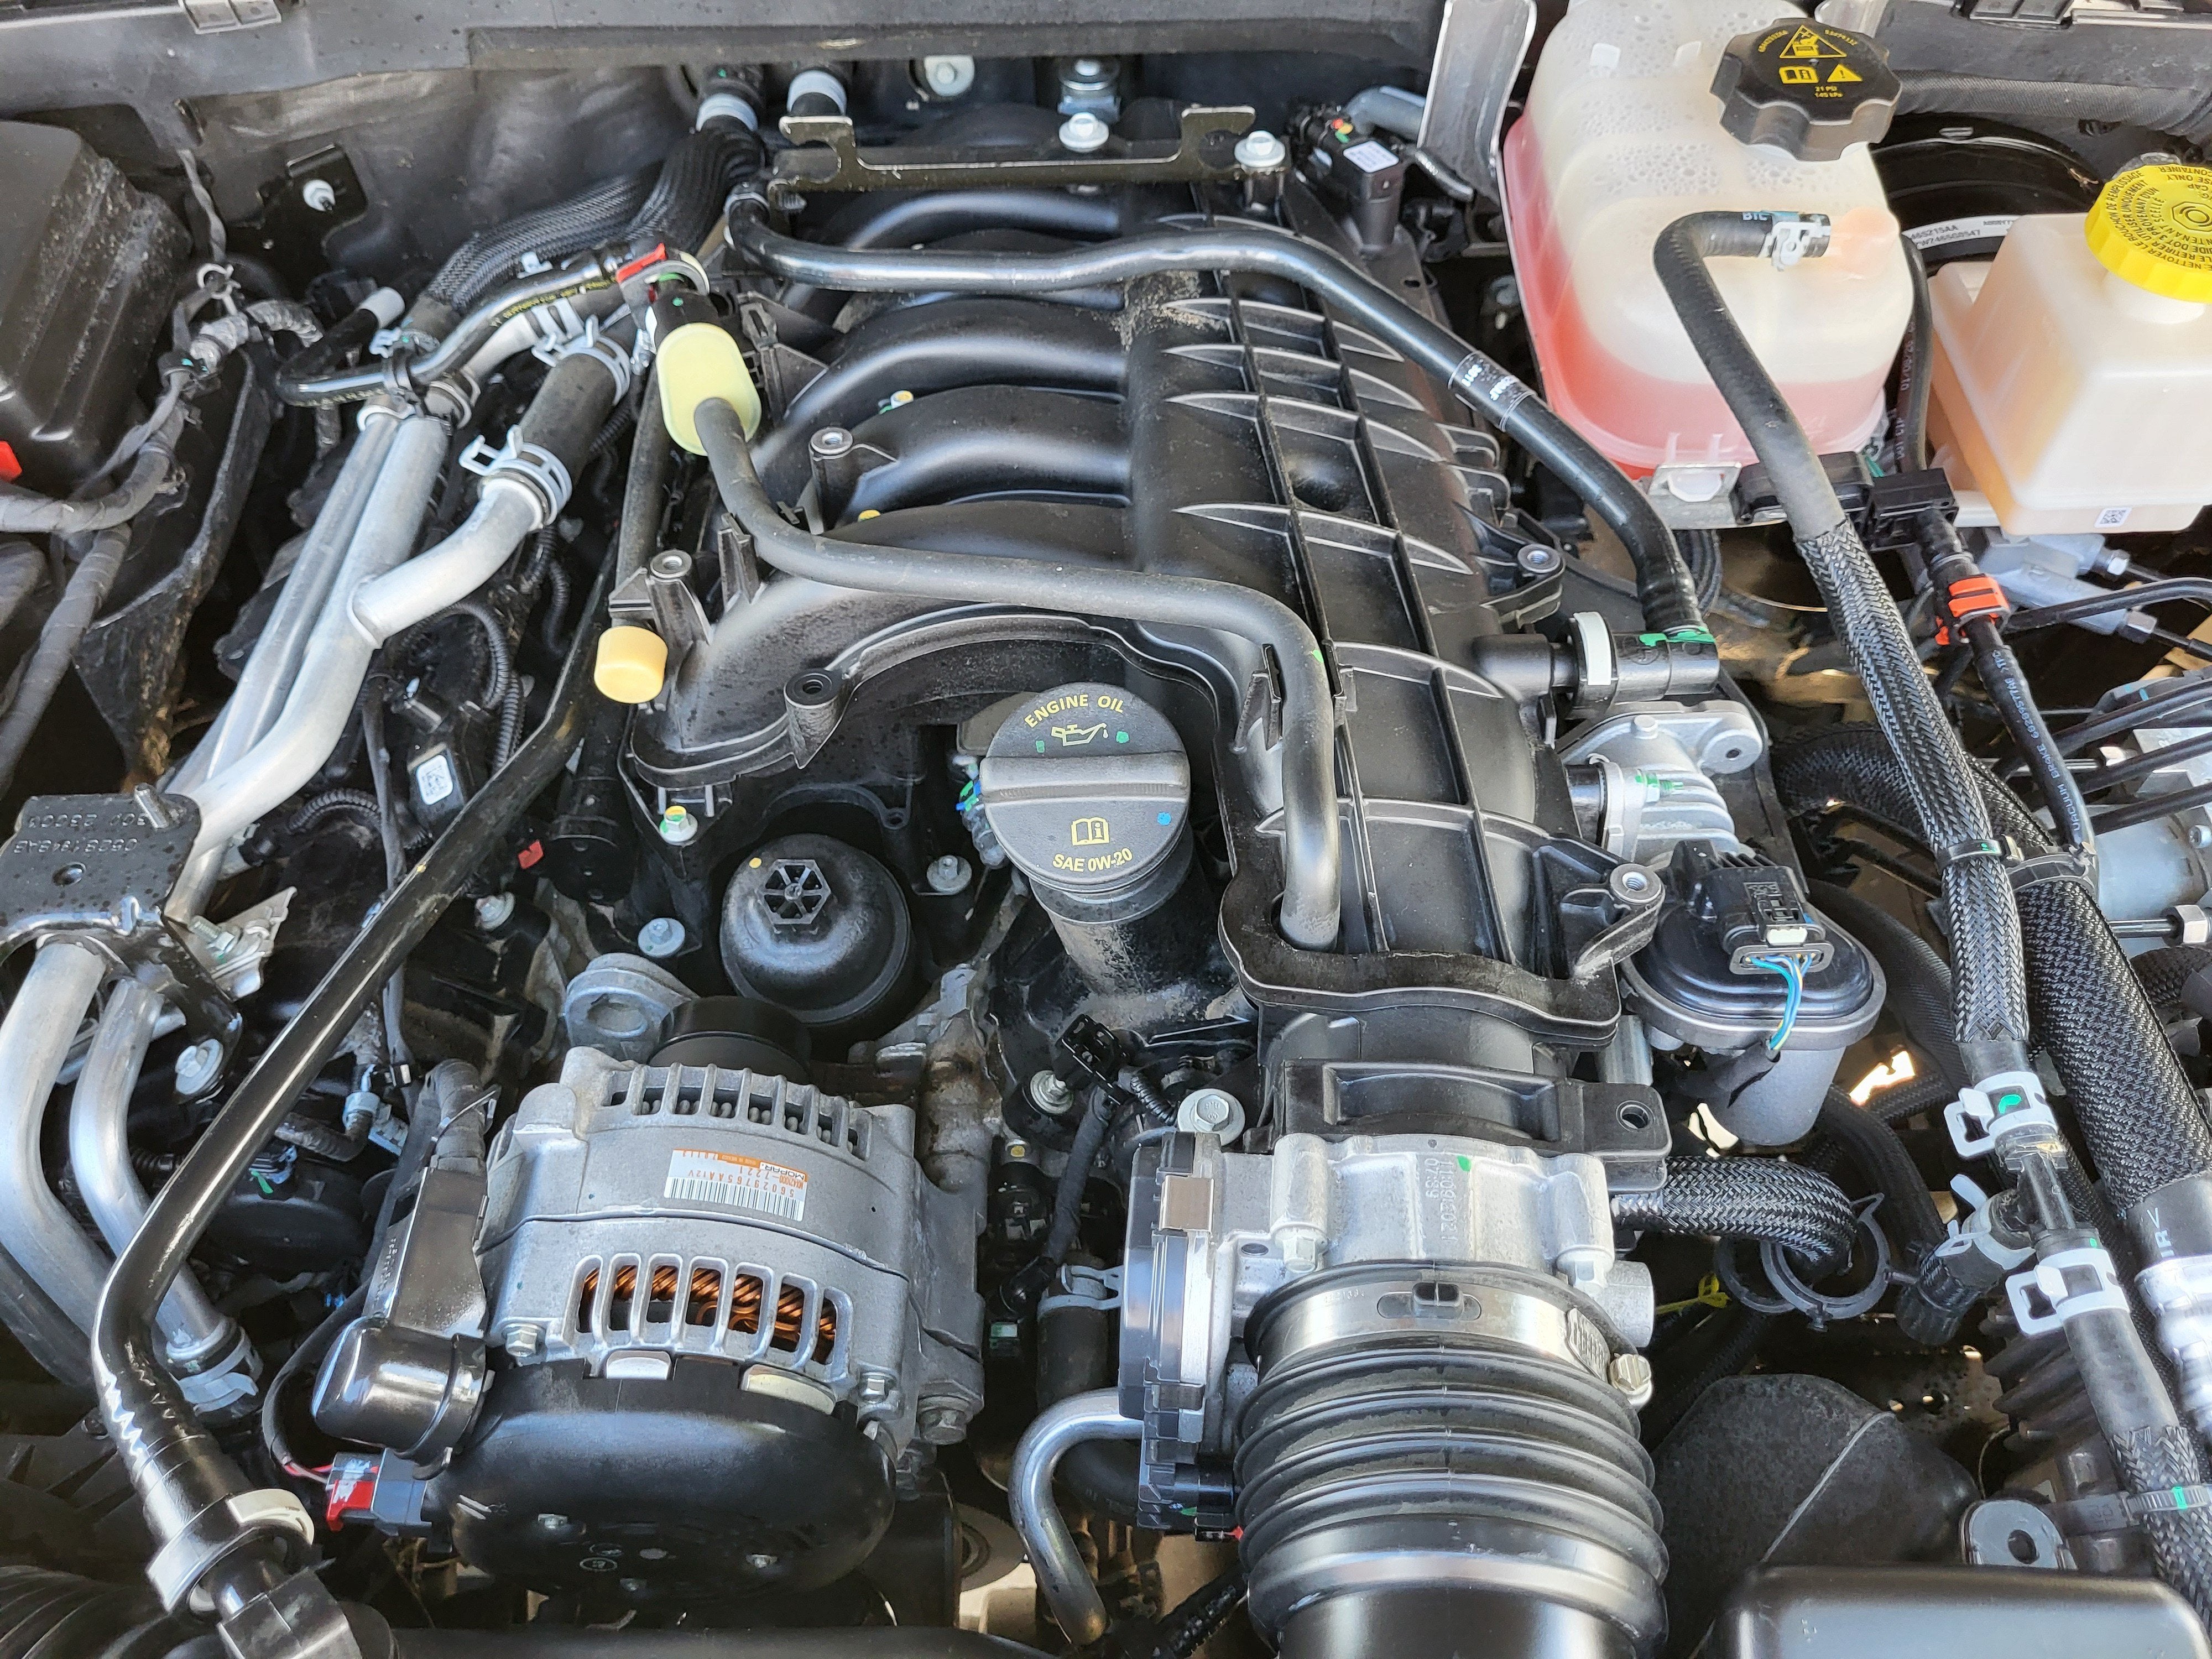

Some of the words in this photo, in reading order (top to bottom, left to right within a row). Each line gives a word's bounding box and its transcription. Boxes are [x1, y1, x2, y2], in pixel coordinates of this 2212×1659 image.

[2188, 183, 2209, 191] CAP
[2106, 202, 2117, 211] DE
[2135, 197, 2161, 236] PROVENANT
[2109, 212, 2138, 242] BOUCHON
[2122, 213, 2152, 241] UTILISER
[2159, 225, 2212, 246] NTENANT
[2135, 241, 2149, 249] LE
[2151, 240, 2195, 260] RETIRER
[2166, 238, 2189, 250] DOT
[2148, 248, 2201, 269] NETTOYER
[1024, 693, 1089, 729] ENGINE
[1097, 695, 1125, 714] OIL
[2036, 743, 2060, 779] BRAKE
[2057, 784, 2080, 831] VACUUM
[1052, 853, 1085, 873] SAE
[1088, 847, 1133, 872] 0W-20
